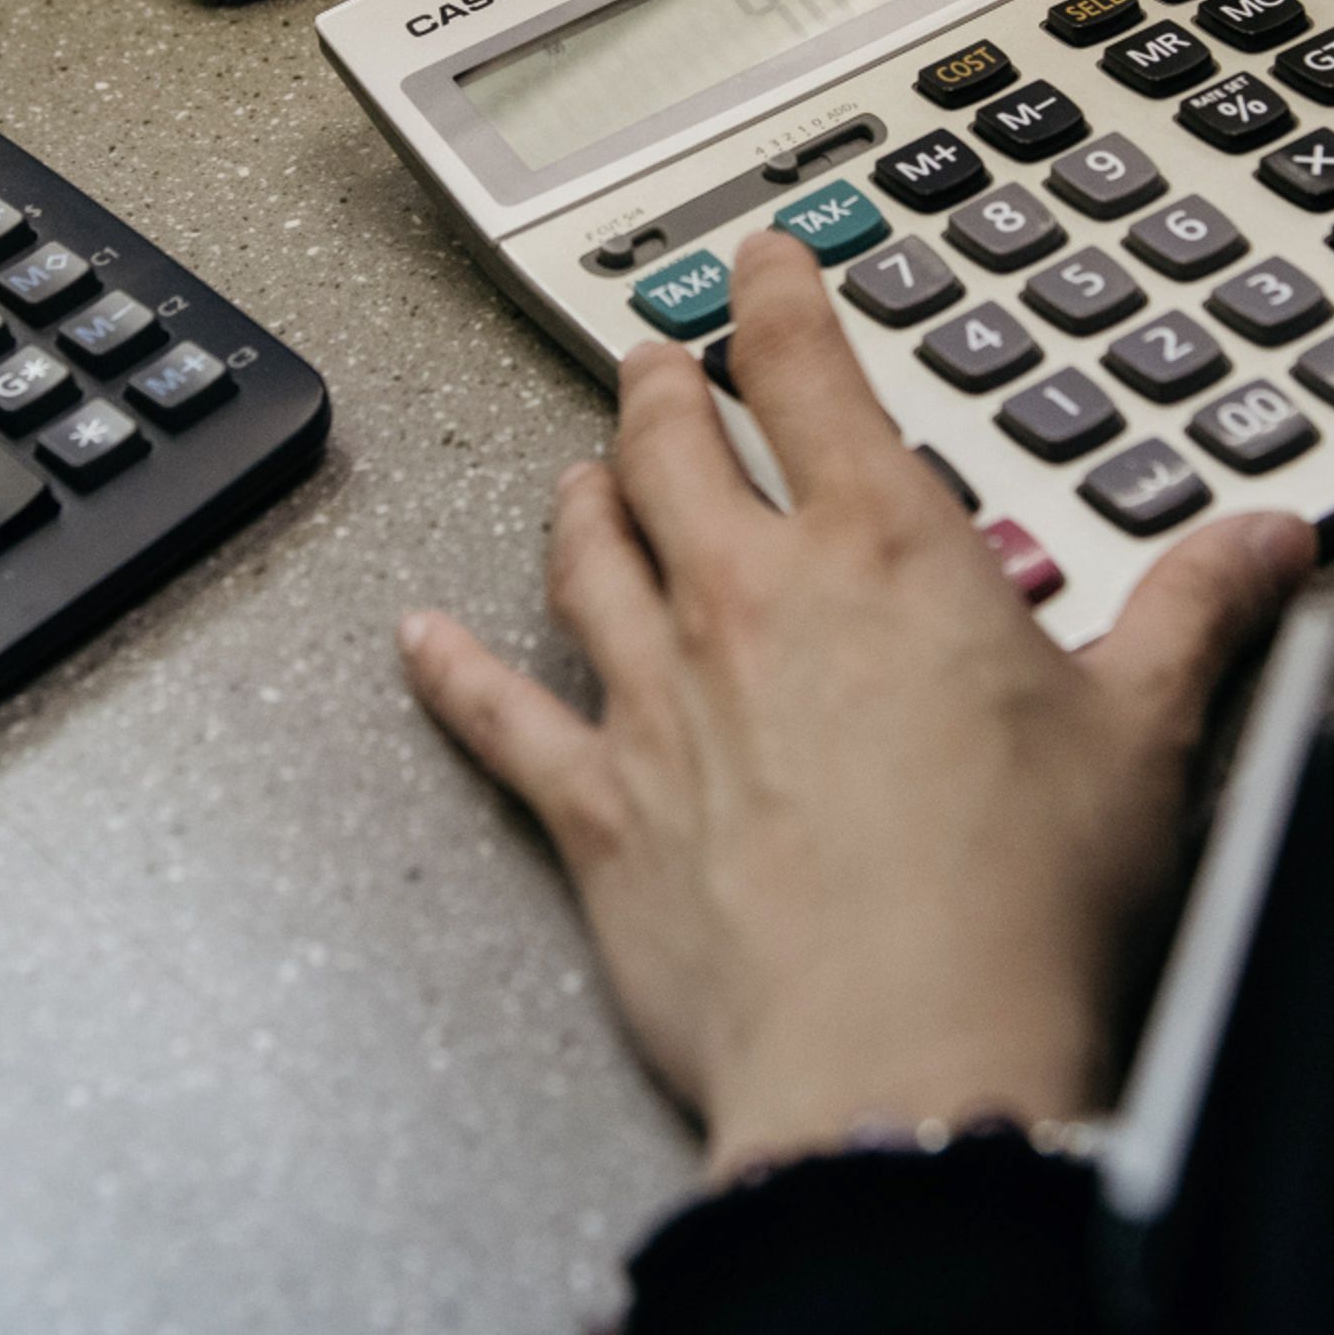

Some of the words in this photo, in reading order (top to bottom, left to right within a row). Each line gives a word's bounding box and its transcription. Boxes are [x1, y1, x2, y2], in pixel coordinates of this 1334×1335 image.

[935, 45, 998, 84] COST
[1125, 30, 1194, 70] MR
[1189, 86, 1227, 110] RATE
[1224, 74, 1251, 96] SET
[895, 141, 960, 183] M+
[1084, 149, 1127, 182] 9
[982, 199, 1027, 234] 8
[1164, 209, 1209, 243] 6
[90, 245, 122, 268] C1
[880, 251, 916, 289] 7
[647, 263, 723, 309] TAX+
[1060, 262, 1107, 297] 5
[1245, 272, 1296, 307] 3
[156, 293, 191, 319] C2
[964, 318, 1004, 354] 4
[1143, 325, 1195, 363] 2
[143, 352, 208, 397] M+
[225, 344, 260, 370] C3
[1041, 385, 1081, 418] 1
[1217, 387, 1293, 439] 00
